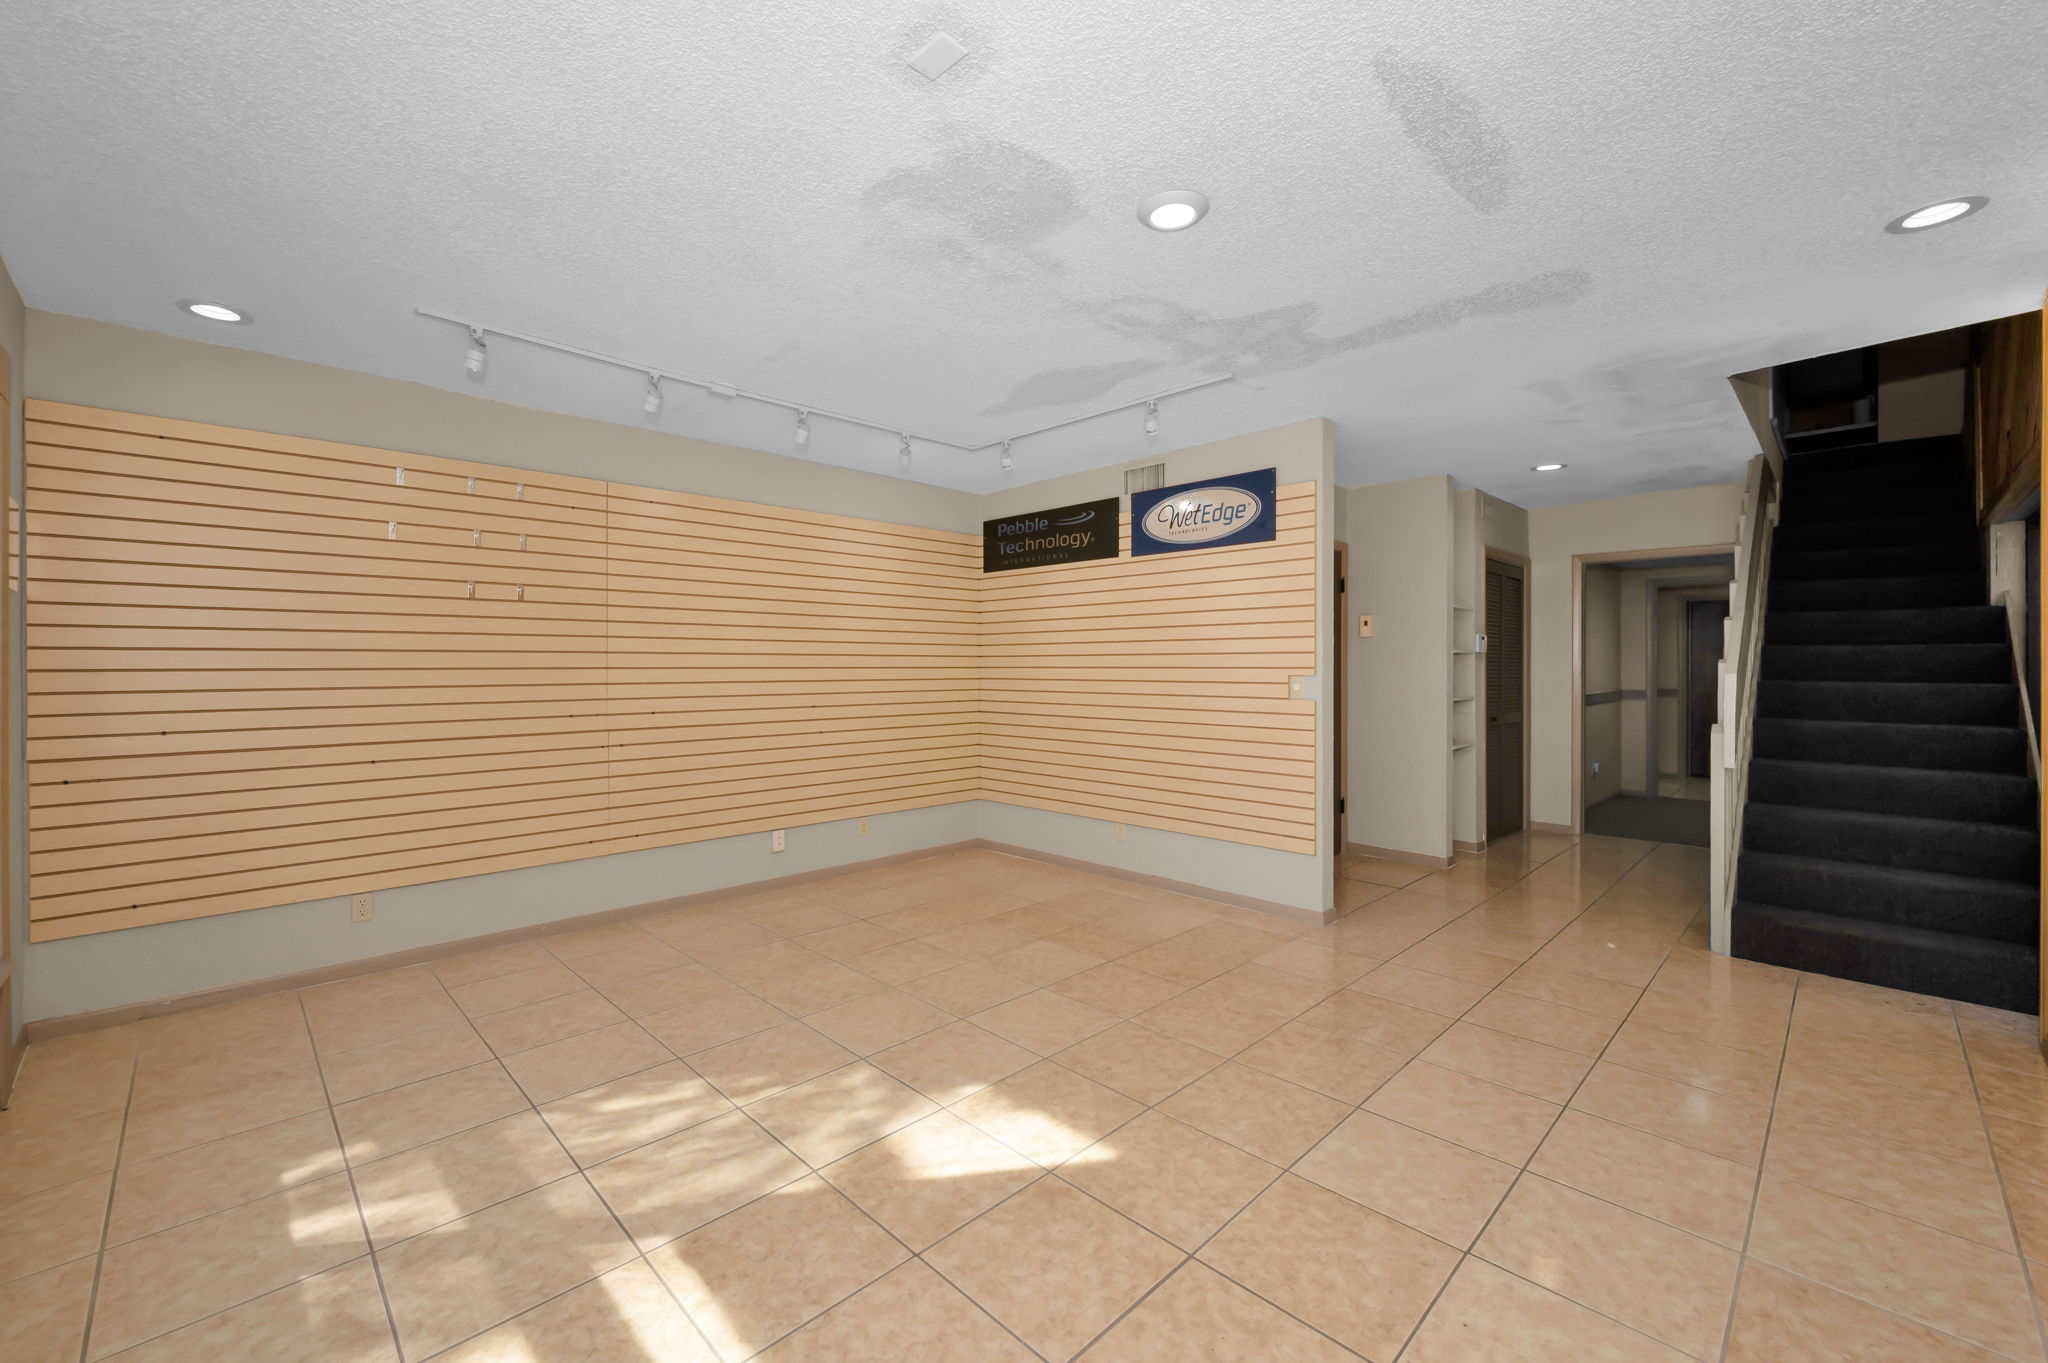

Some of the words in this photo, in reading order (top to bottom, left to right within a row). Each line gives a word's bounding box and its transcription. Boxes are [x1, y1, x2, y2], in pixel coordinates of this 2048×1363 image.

[1158, 502, 1246, 529] WetEdge
[998, 517, 1048, 537] Pebble
[1168, 526, 1208, 536] TECHNOLOGIES
[998, 531, 1091, 555] Technology
[1001, 553, 1068, 566] INTERNATIONAL
